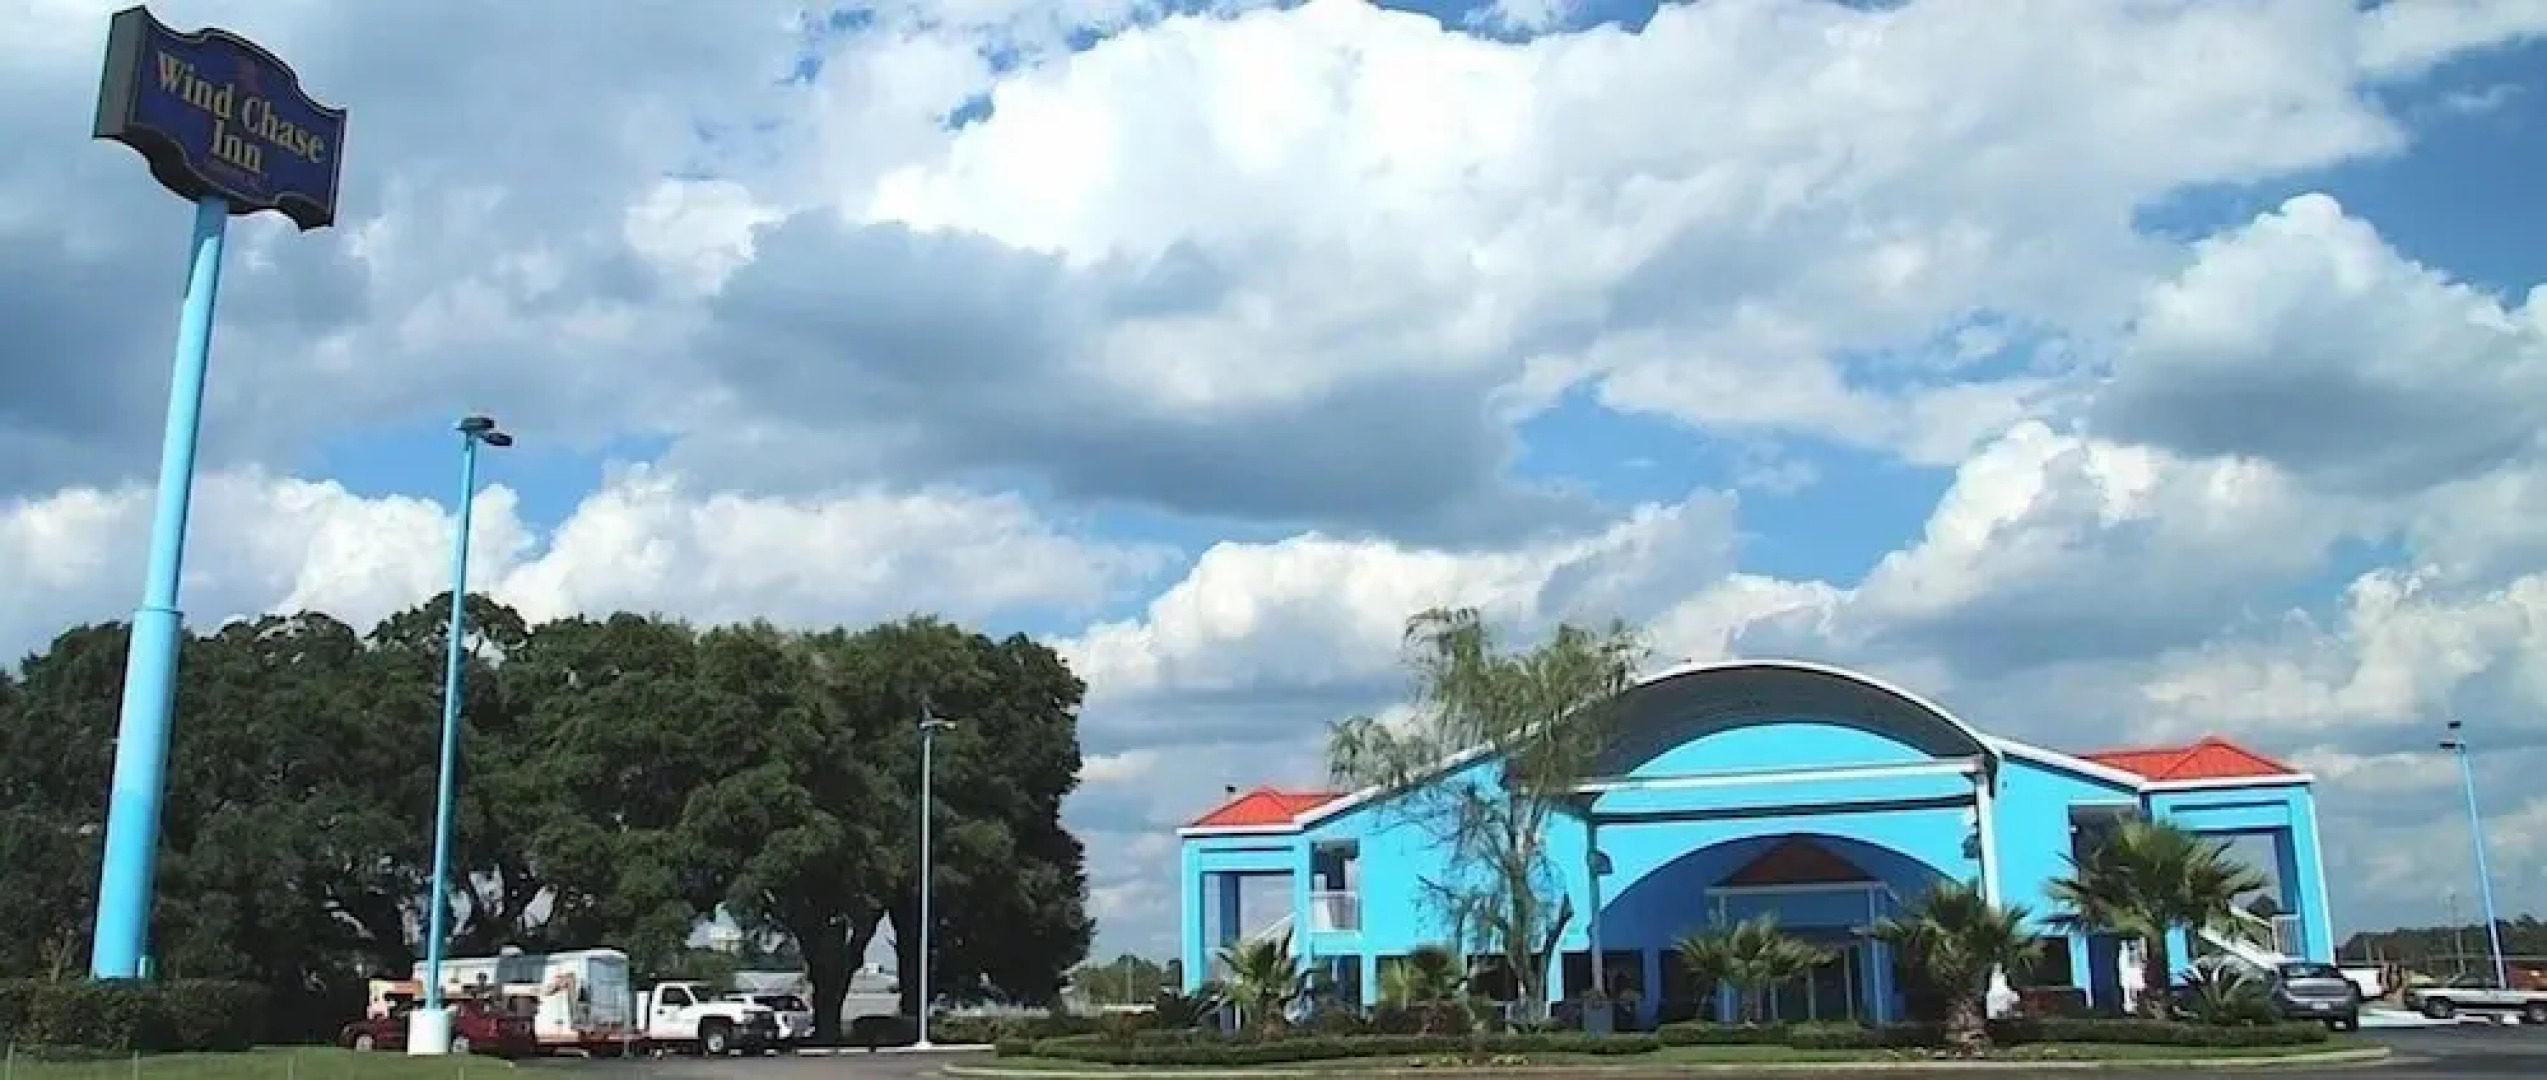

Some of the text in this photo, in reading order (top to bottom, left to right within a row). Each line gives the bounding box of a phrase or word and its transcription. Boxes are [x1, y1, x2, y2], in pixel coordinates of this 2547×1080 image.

[159, 52, 324, 163] Wind Chase
[212, 120, 261, 172] Inn
